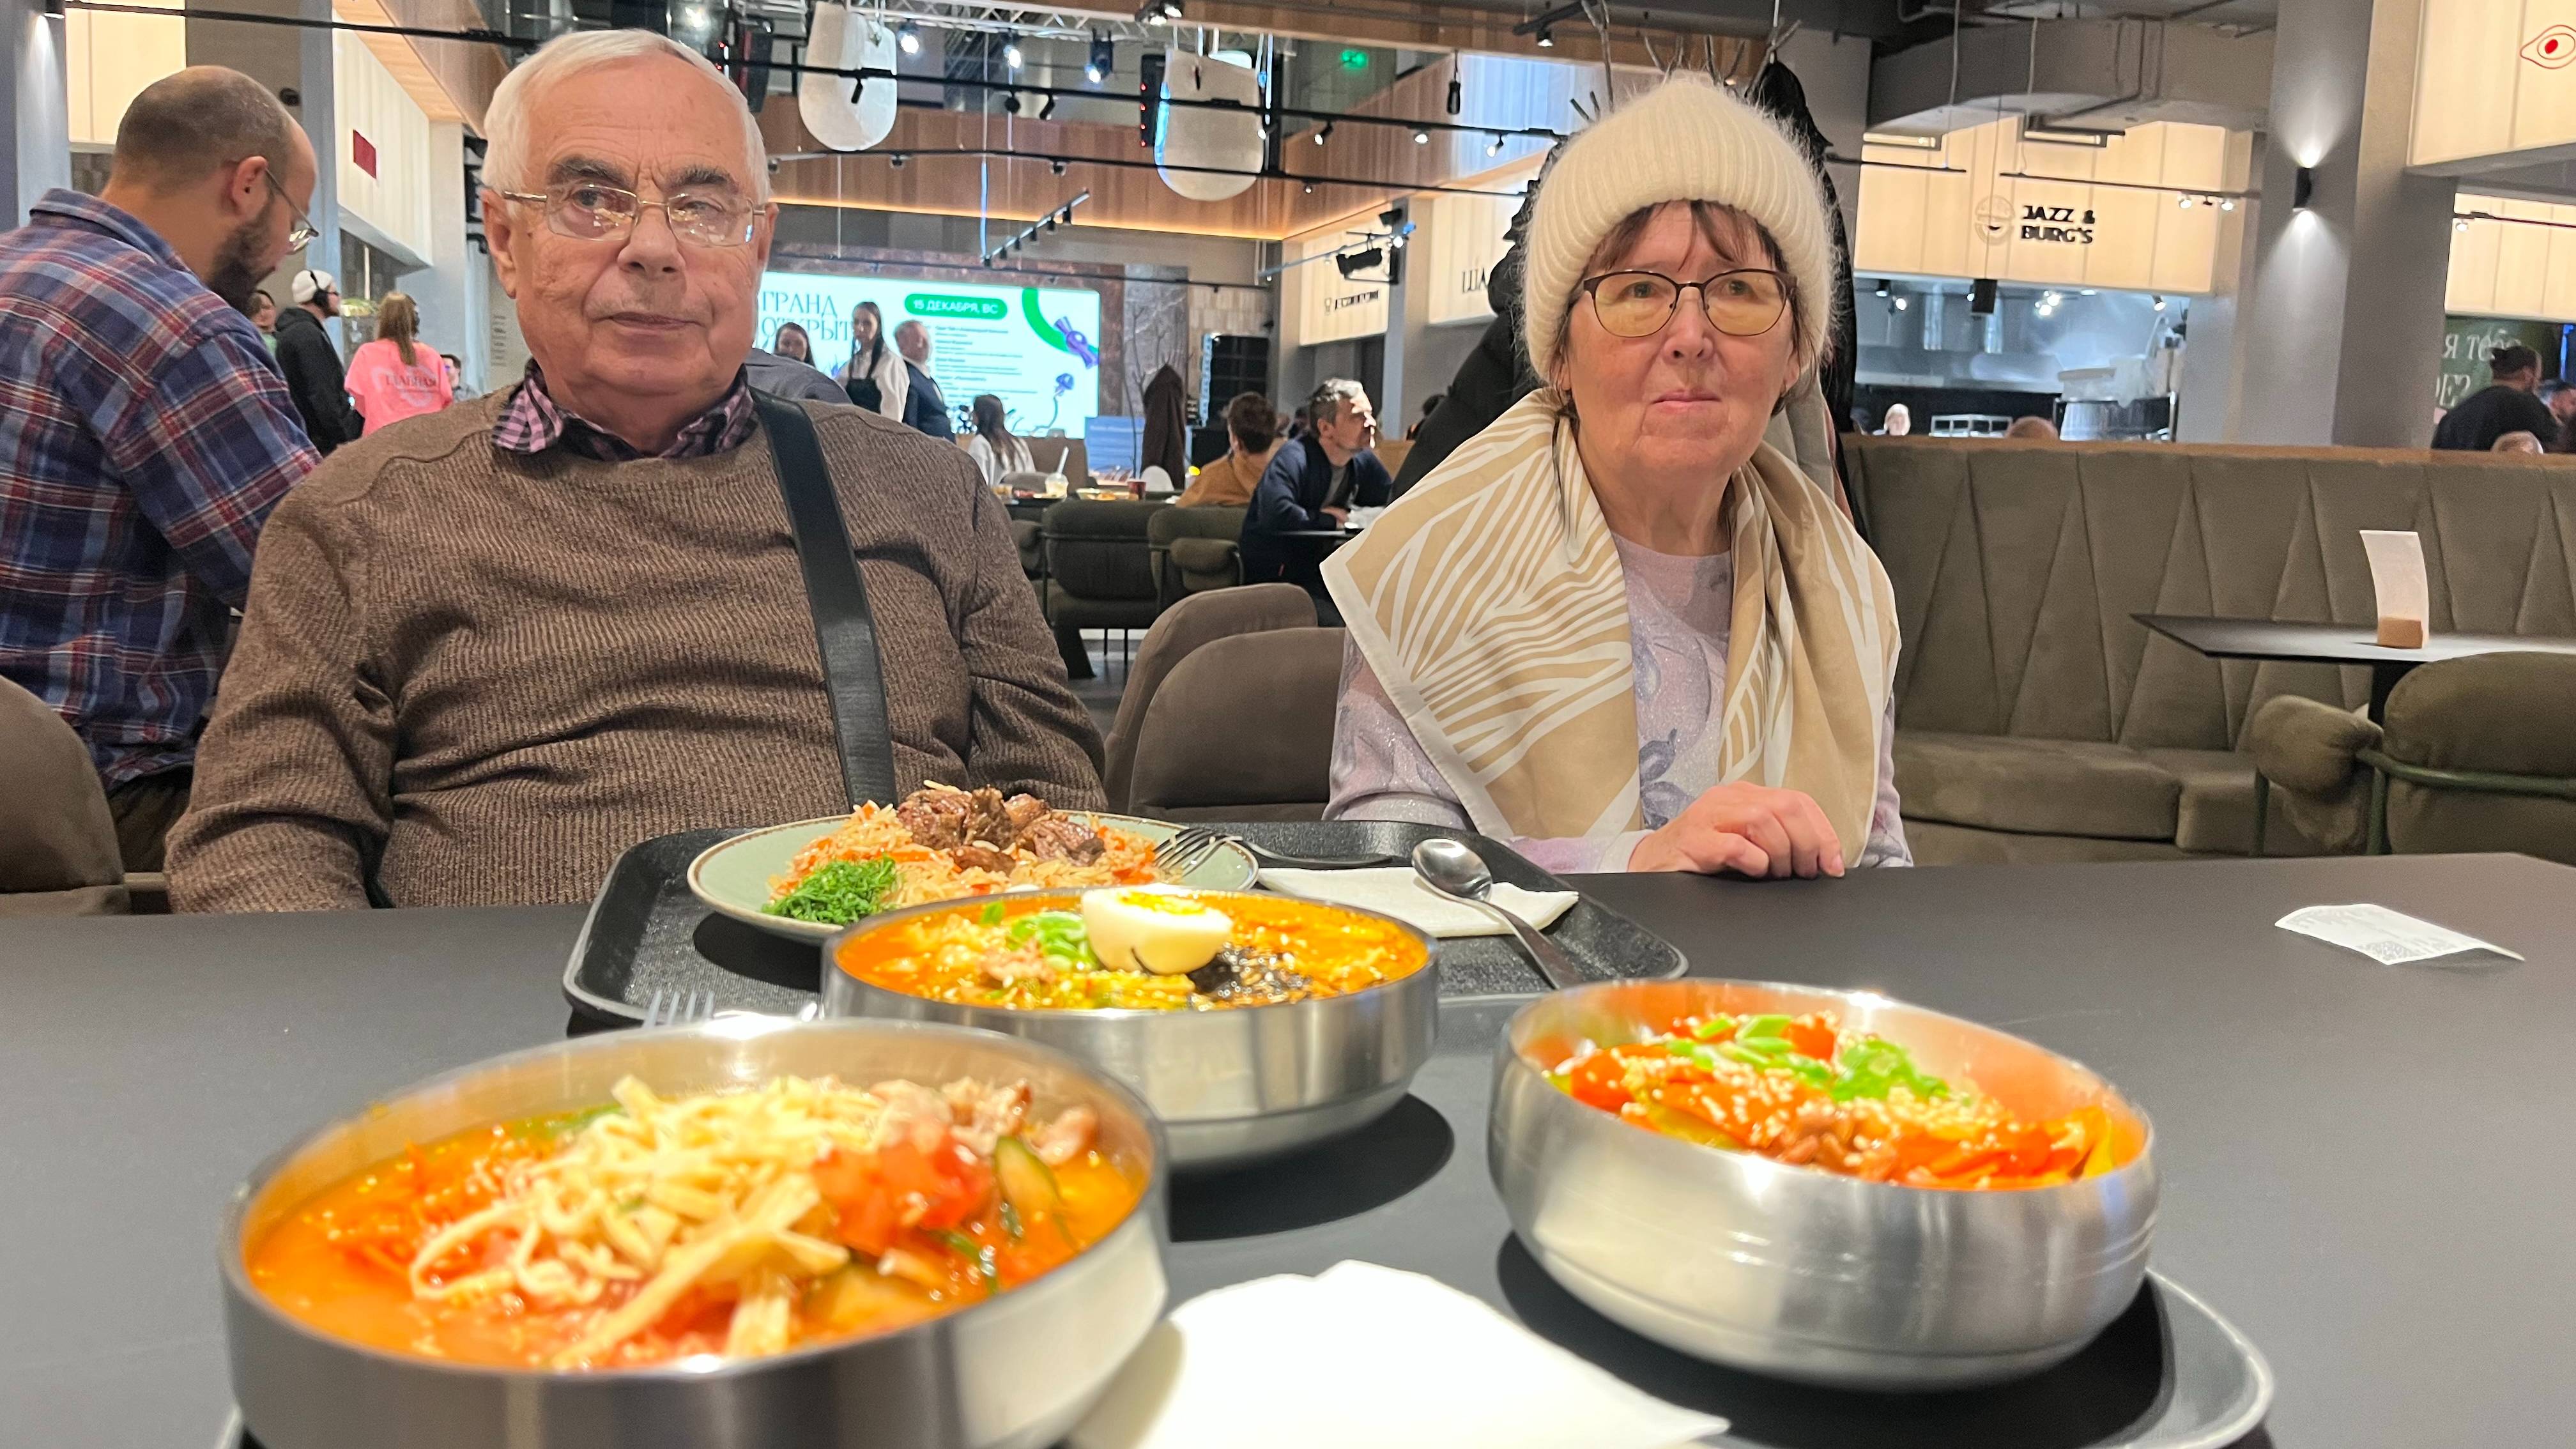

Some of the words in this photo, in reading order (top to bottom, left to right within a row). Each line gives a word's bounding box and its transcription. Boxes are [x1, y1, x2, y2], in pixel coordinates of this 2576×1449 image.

[2022, 205, 2074, 223] JAZZ
[2083, 210, 2095, 224] &
[2020, 225, 2093, 244] BURG'S
[762, 291, 838, 318] ГРАНД
[926, 300, 980, 314] ДЕКАБРЯ,
[982, 303, 999, 314] ВС
[762, 317, 850, 341] ОРЫТ
